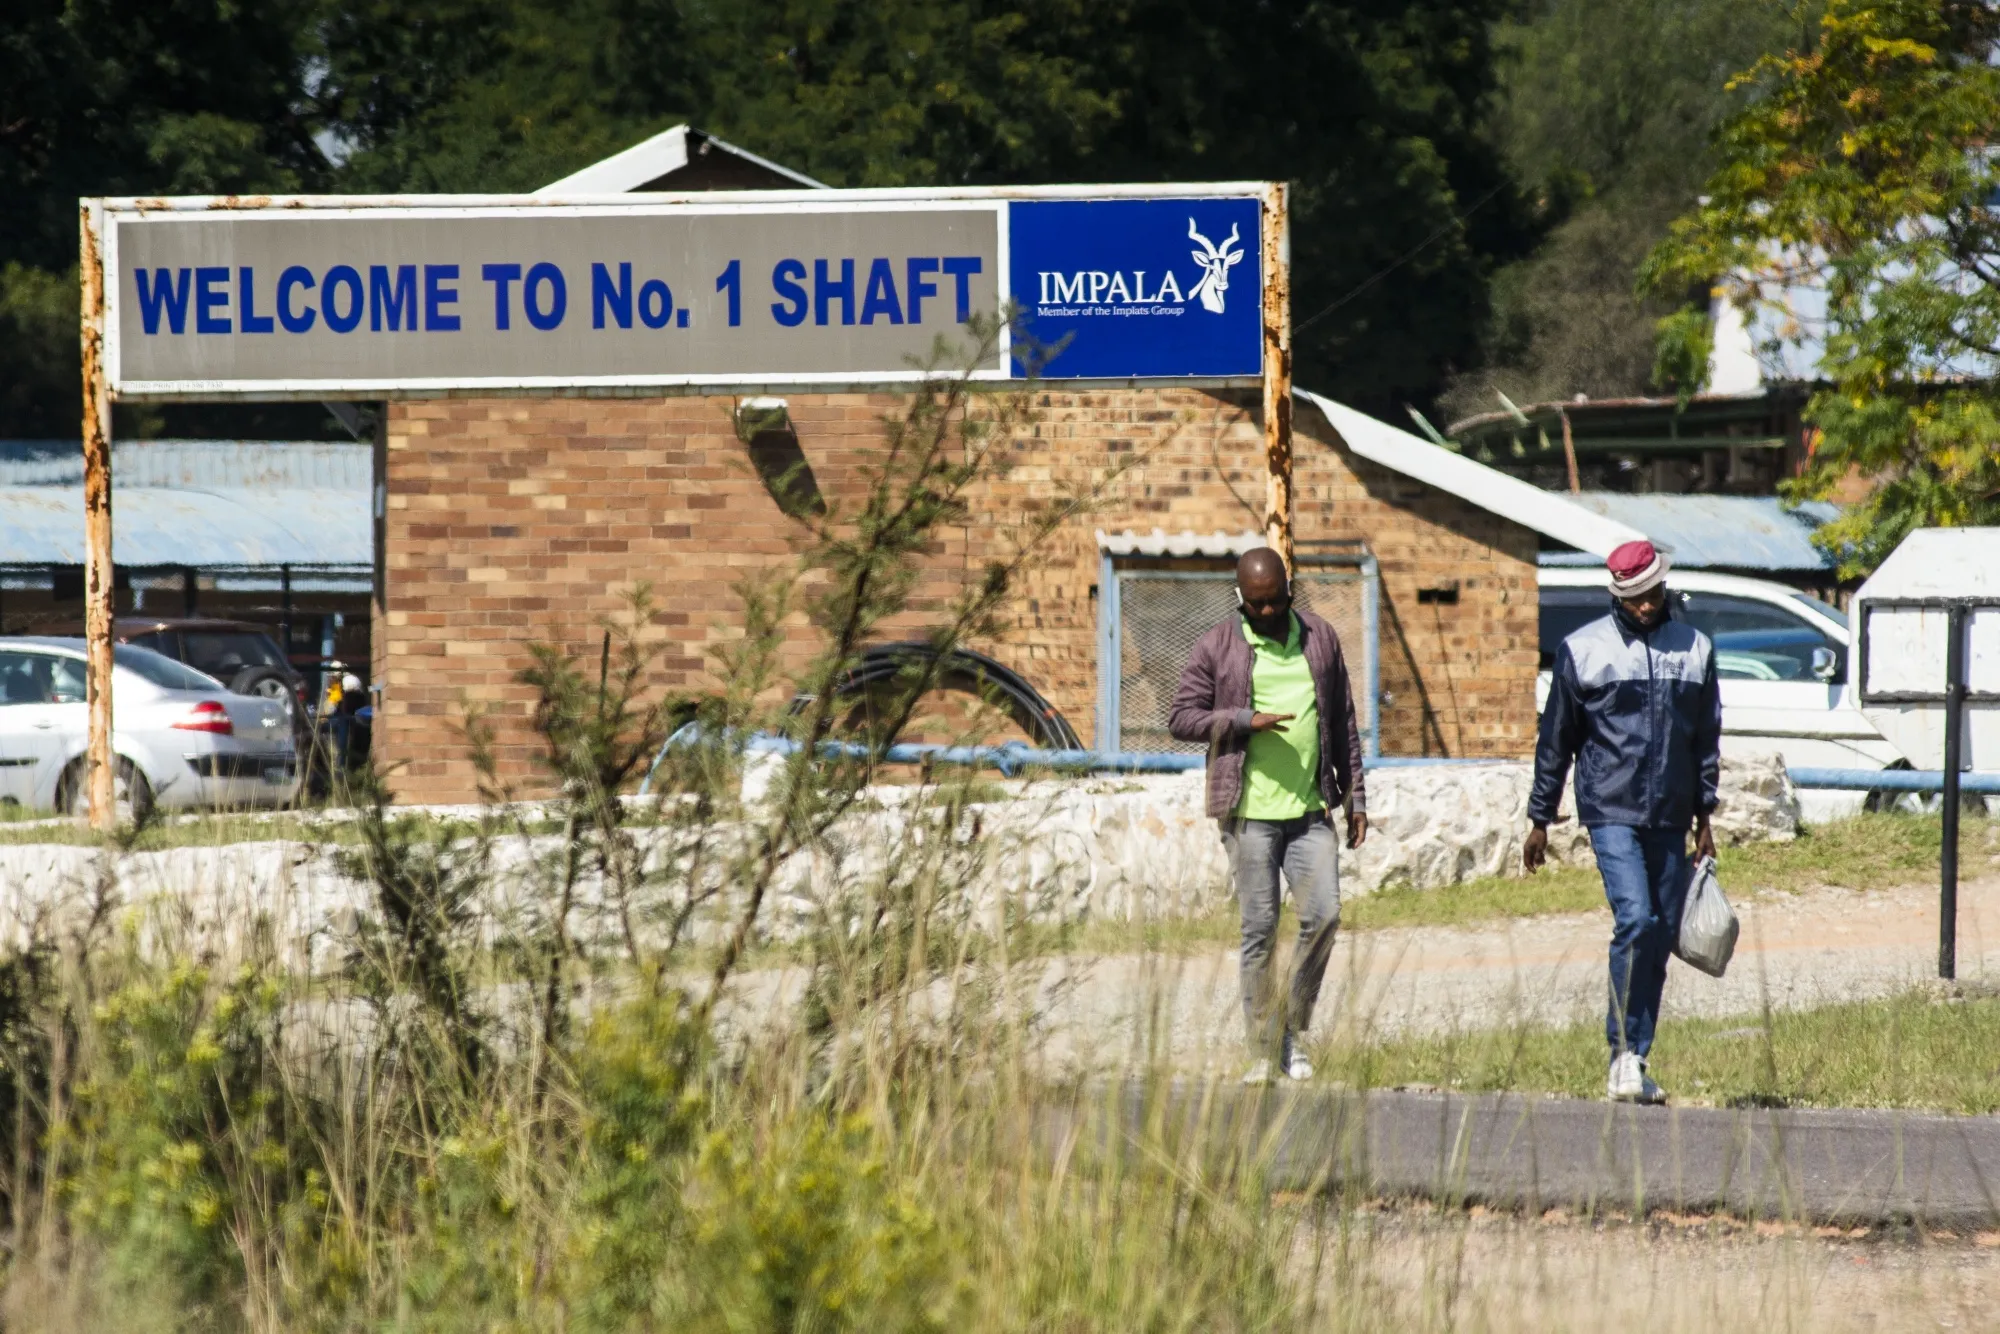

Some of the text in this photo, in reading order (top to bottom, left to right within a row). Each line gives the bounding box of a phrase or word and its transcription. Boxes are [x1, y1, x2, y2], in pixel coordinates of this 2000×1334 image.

[135, 257, 982, 335] WELCOME TO No. 1 SHAFT
[1037, 270, 1186, 304] IMPALA
[1037, 305, 1185, 318] Member of the Implats Group
